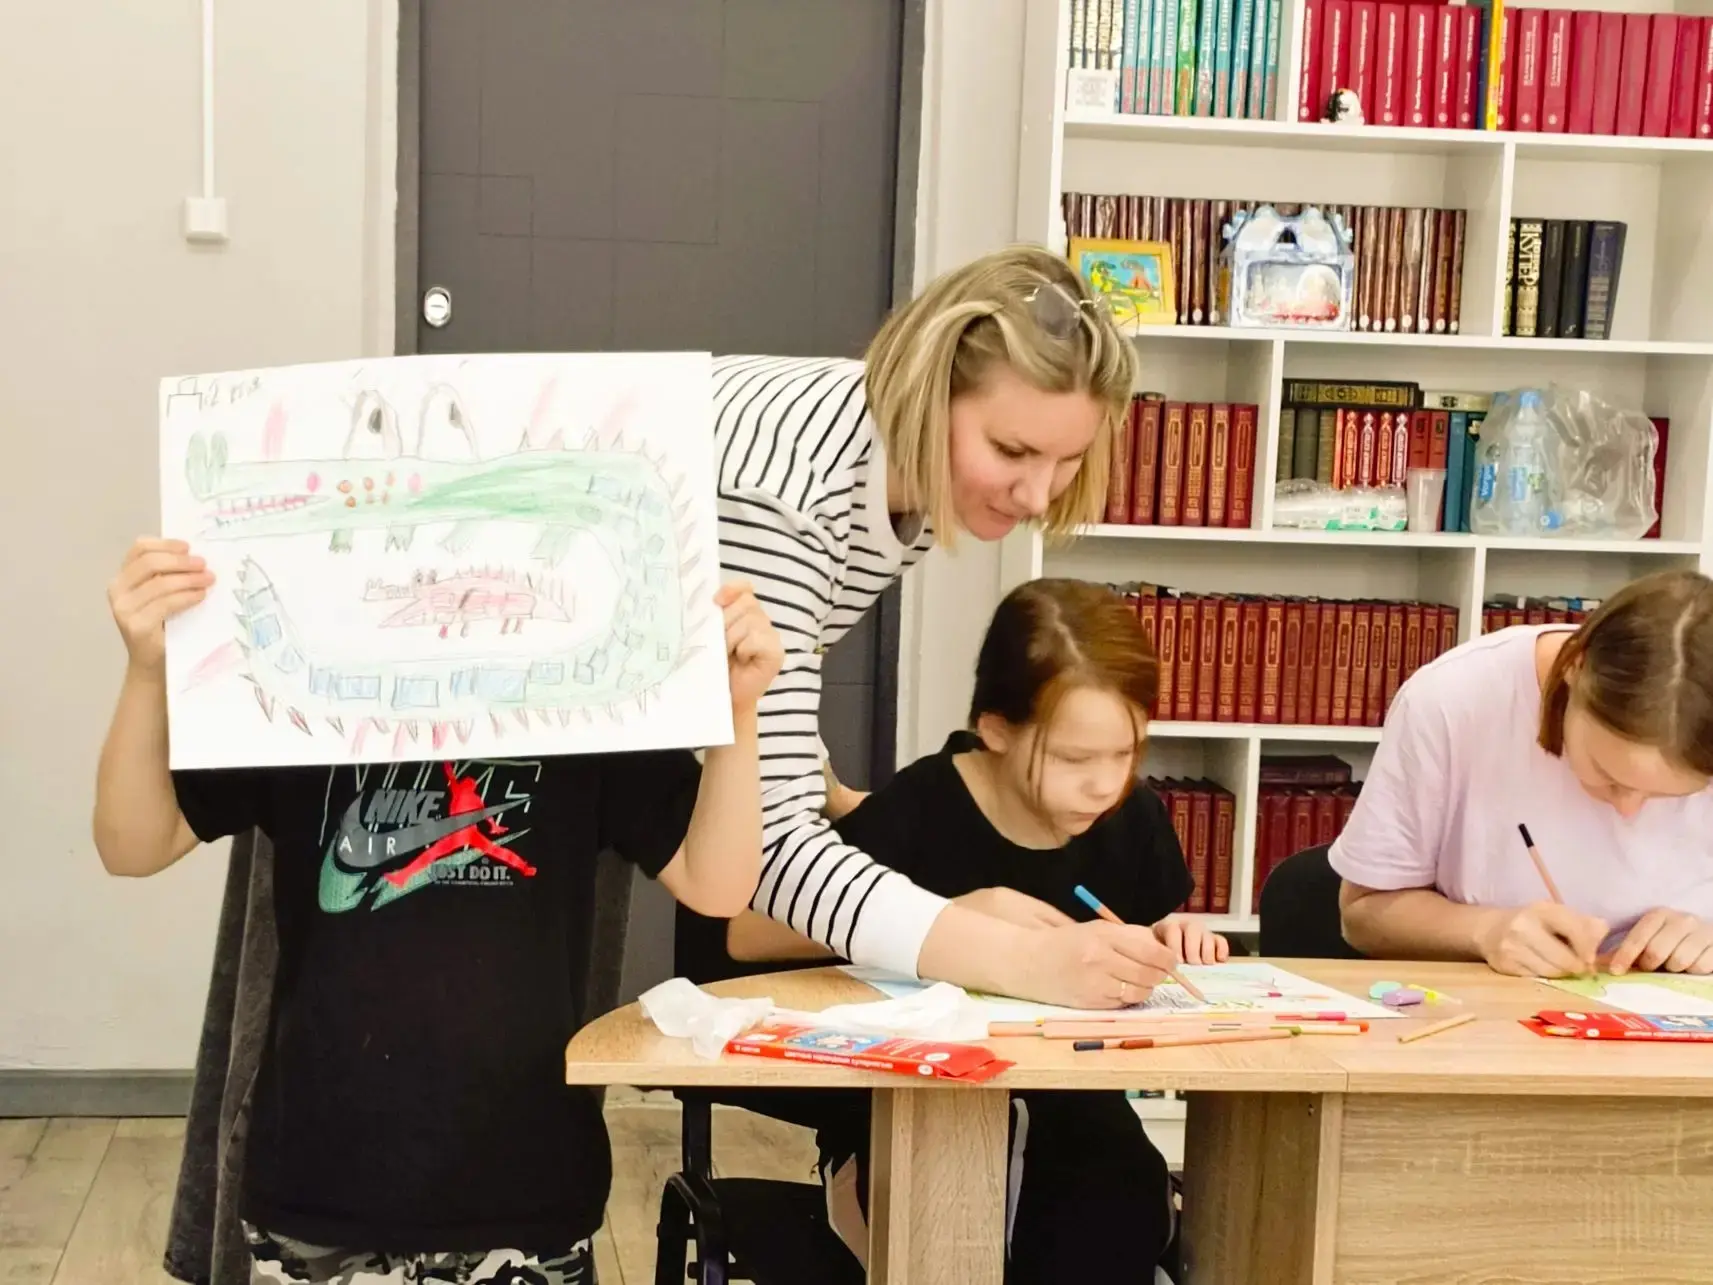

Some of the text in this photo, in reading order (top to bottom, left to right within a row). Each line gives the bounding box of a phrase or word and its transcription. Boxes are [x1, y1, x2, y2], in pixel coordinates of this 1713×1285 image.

[364, 790, 445, 824] NIKE
[340, 837, 397, 854] AIR
[429, 864, 511, 881] JUST DO IT.
